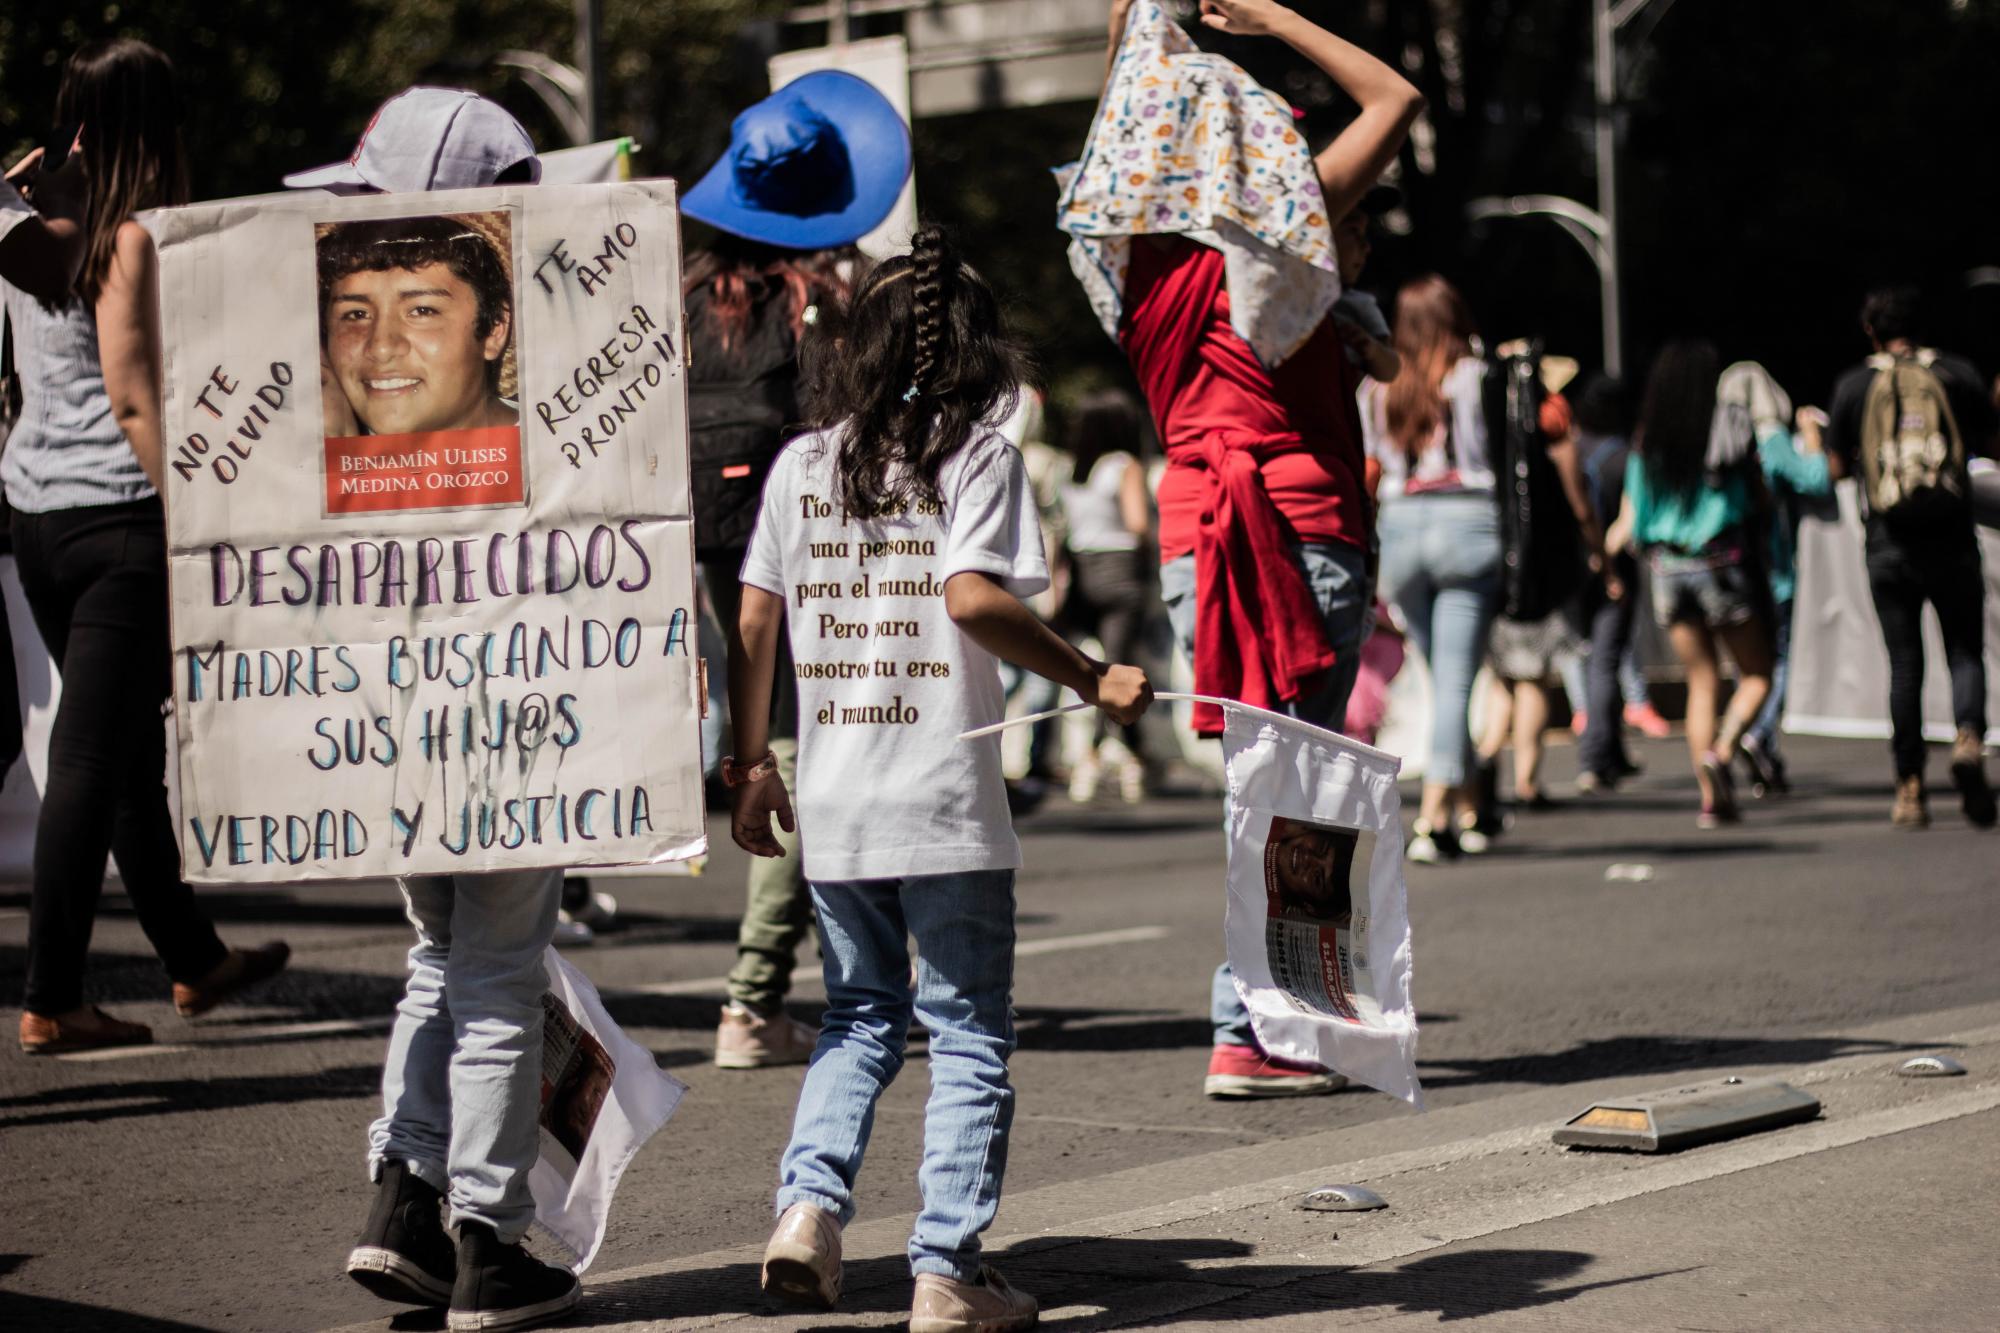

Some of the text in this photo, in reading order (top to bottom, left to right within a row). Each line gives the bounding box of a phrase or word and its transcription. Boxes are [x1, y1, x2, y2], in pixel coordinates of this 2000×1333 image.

[533, 238, 577, 295] TE
[577, 222, 638, 297] AMO
[536, 304, 657, 435] REGRESA
[561, 332, 682, 470] PRONTO!!
[172, 364, 239, 483] NO TE
[212, 361, 294, 485] OLVIDO
[339, 469, 509, 496] MEDINA OROZCO
[800, 494, 948, 527] Tío pedes ser
[210, 519, 652, 608] DESAPARECIDOS
[796, 572, 943, 608] para el mundo
[810, 539, 936, 567] una persona
[187, 607, 689, 701] MADRES BUSCANDO A
[818, 614, 868, 639] Pero
[874, 658, 898, 677] tu
[906, 660, 950, 678] eres
[307, 692, 581, 770] SUS HIJ@S
[817, 696, 919, 726] el mundo
[190, 785, 654, 868] VERDAD Y JUSTICIA
